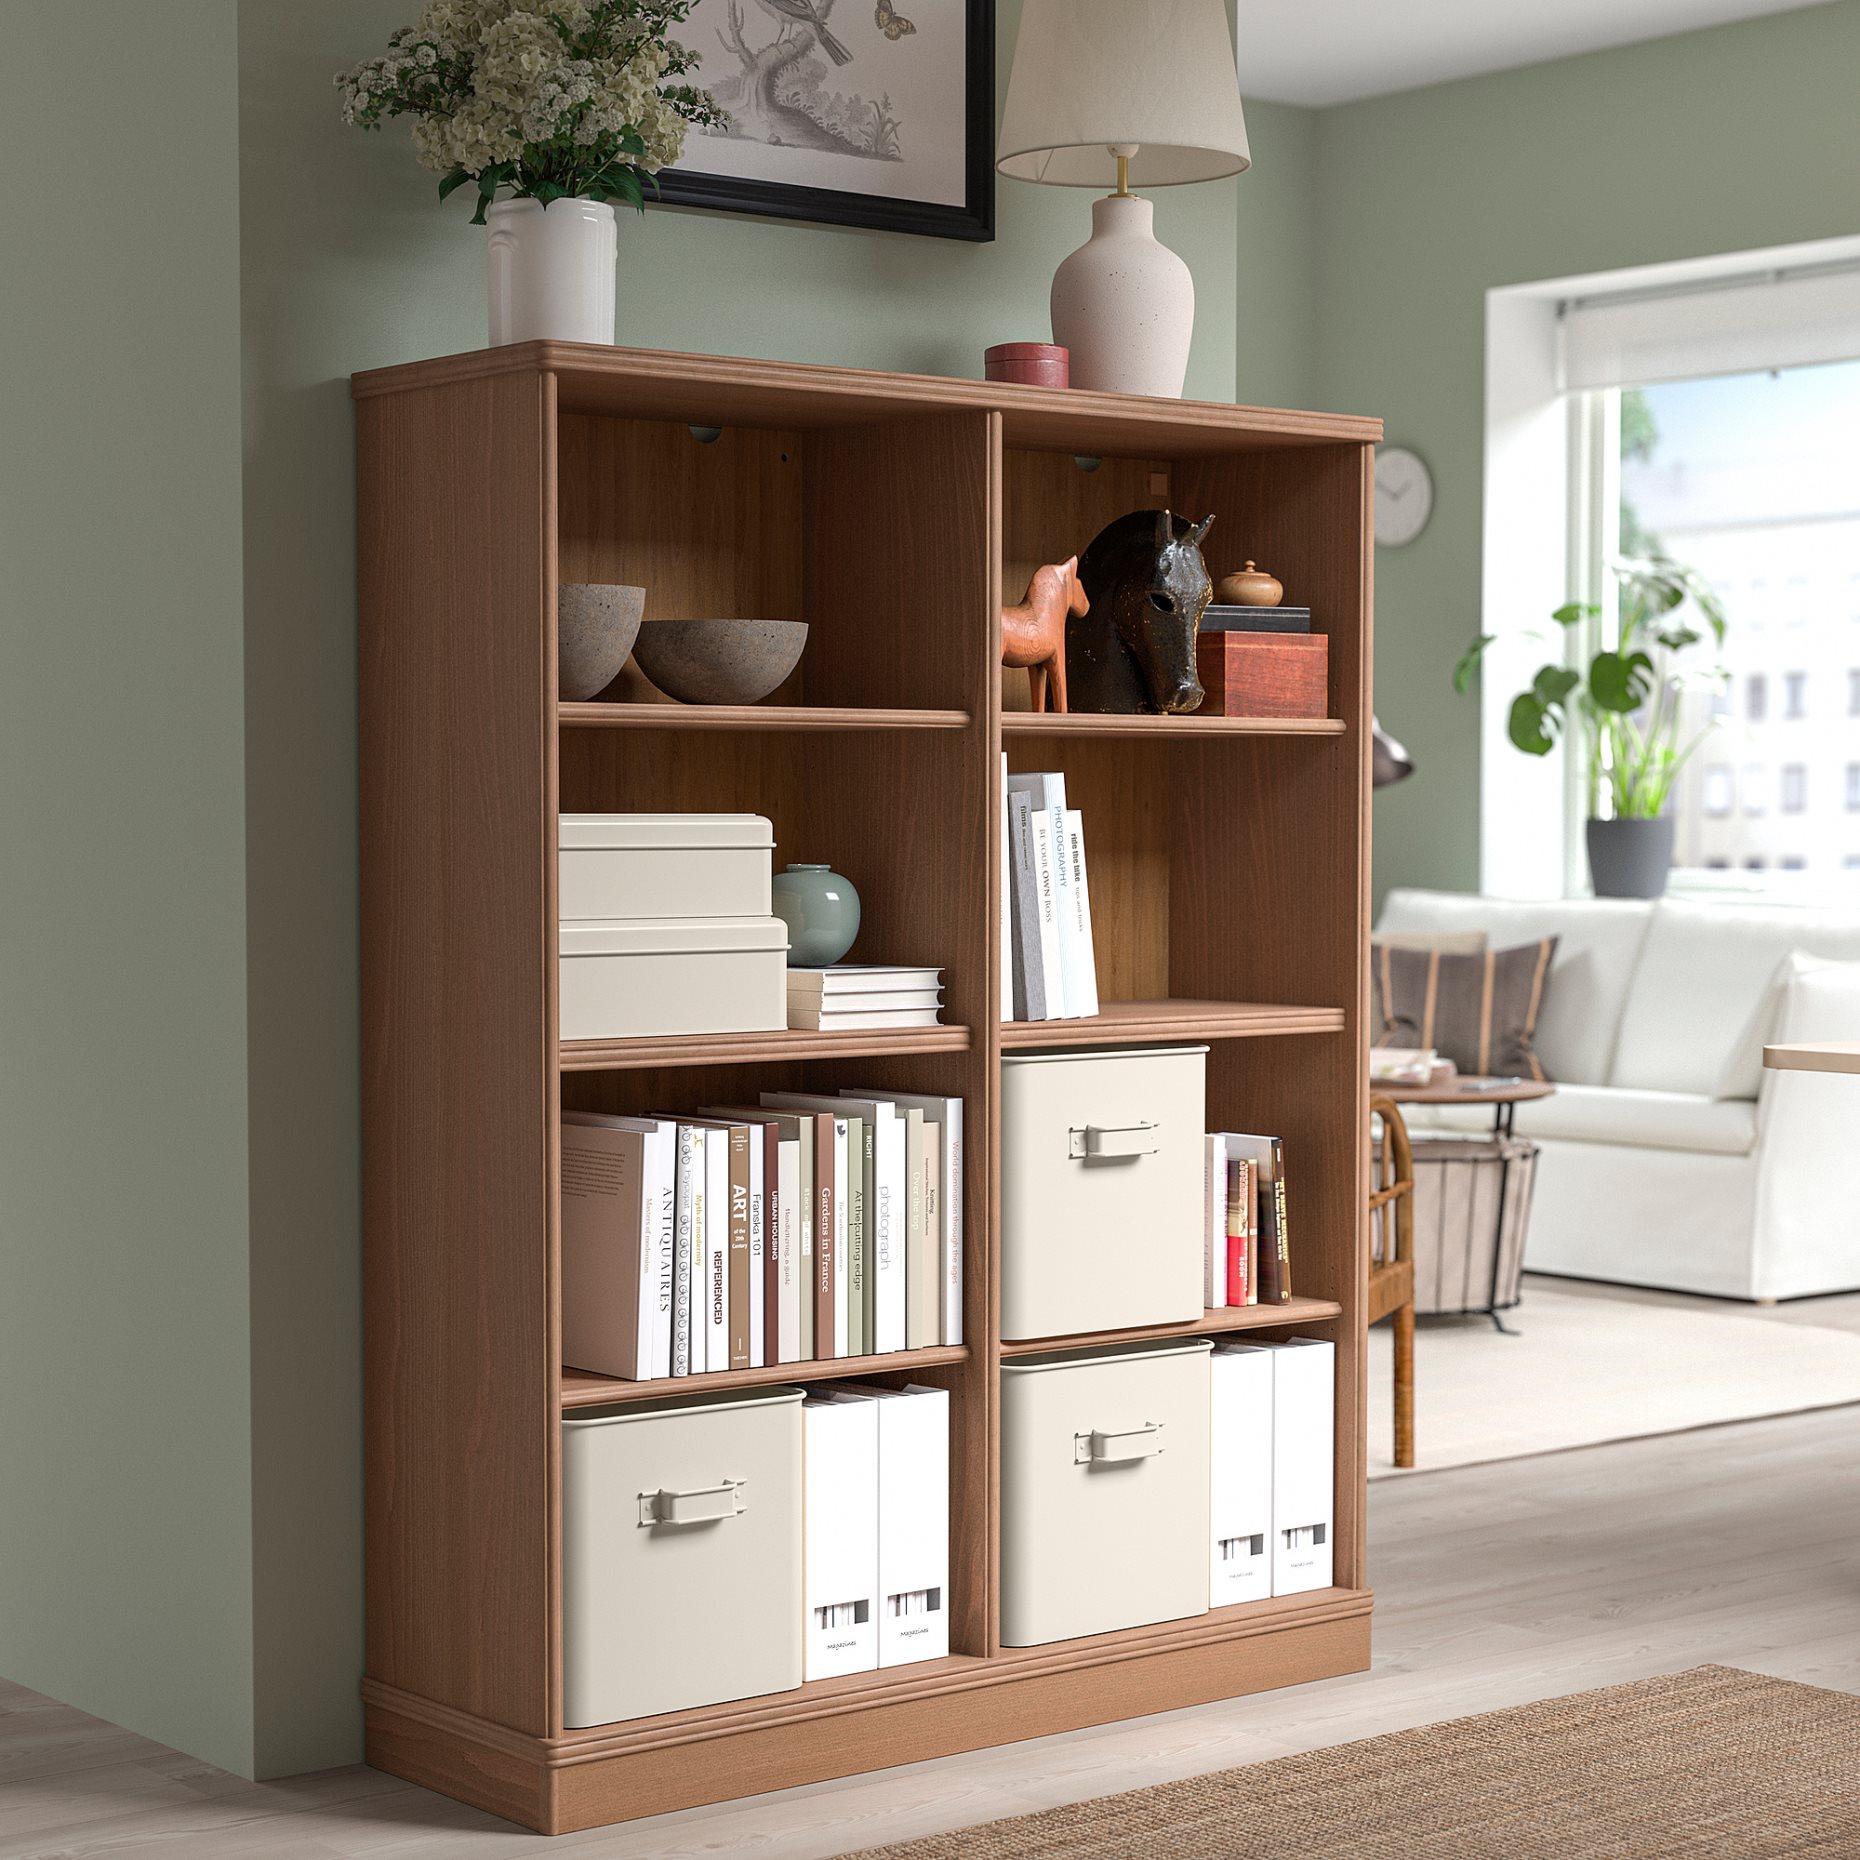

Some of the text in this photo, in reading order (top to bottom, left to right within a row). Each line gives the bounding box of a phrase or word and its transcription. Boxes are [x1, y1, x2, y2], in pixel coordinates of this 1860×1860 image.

[1040, 829, 1046, 841] BE
[1054, 805, 1068, 888] PHOTOGRAPHY
[1070, 833, 1079, 849] ride
[1040, 842, 1048, 868] YOUR
[1072, 850, 1080, 863] the
[1073, 865, 1082, 882] bike
[1042, 870, 1050, 897] OWN
[732, 1183, 746, 1222] ART
[912, 1172, 920, 1196] Over
[644, 1198, 653, 1274] Masters of modernism
[694, 1195, 703, 1266] Myth of modernity
[752, 1194, 761, 1256] Franska 101
[822, 1187, 830, 1292] Gardens in France
[853, 1190, 862, 1290] At the cutting edge
[878, 1186, 892, 1270] photograph
[912, 1214, 920, 1230] top
[950, 1216, 960, 1248] through
[659, 1187, 673, 1312] ANTIQUAIRES
[713, 1250, 722, 1325] REFERENCED
